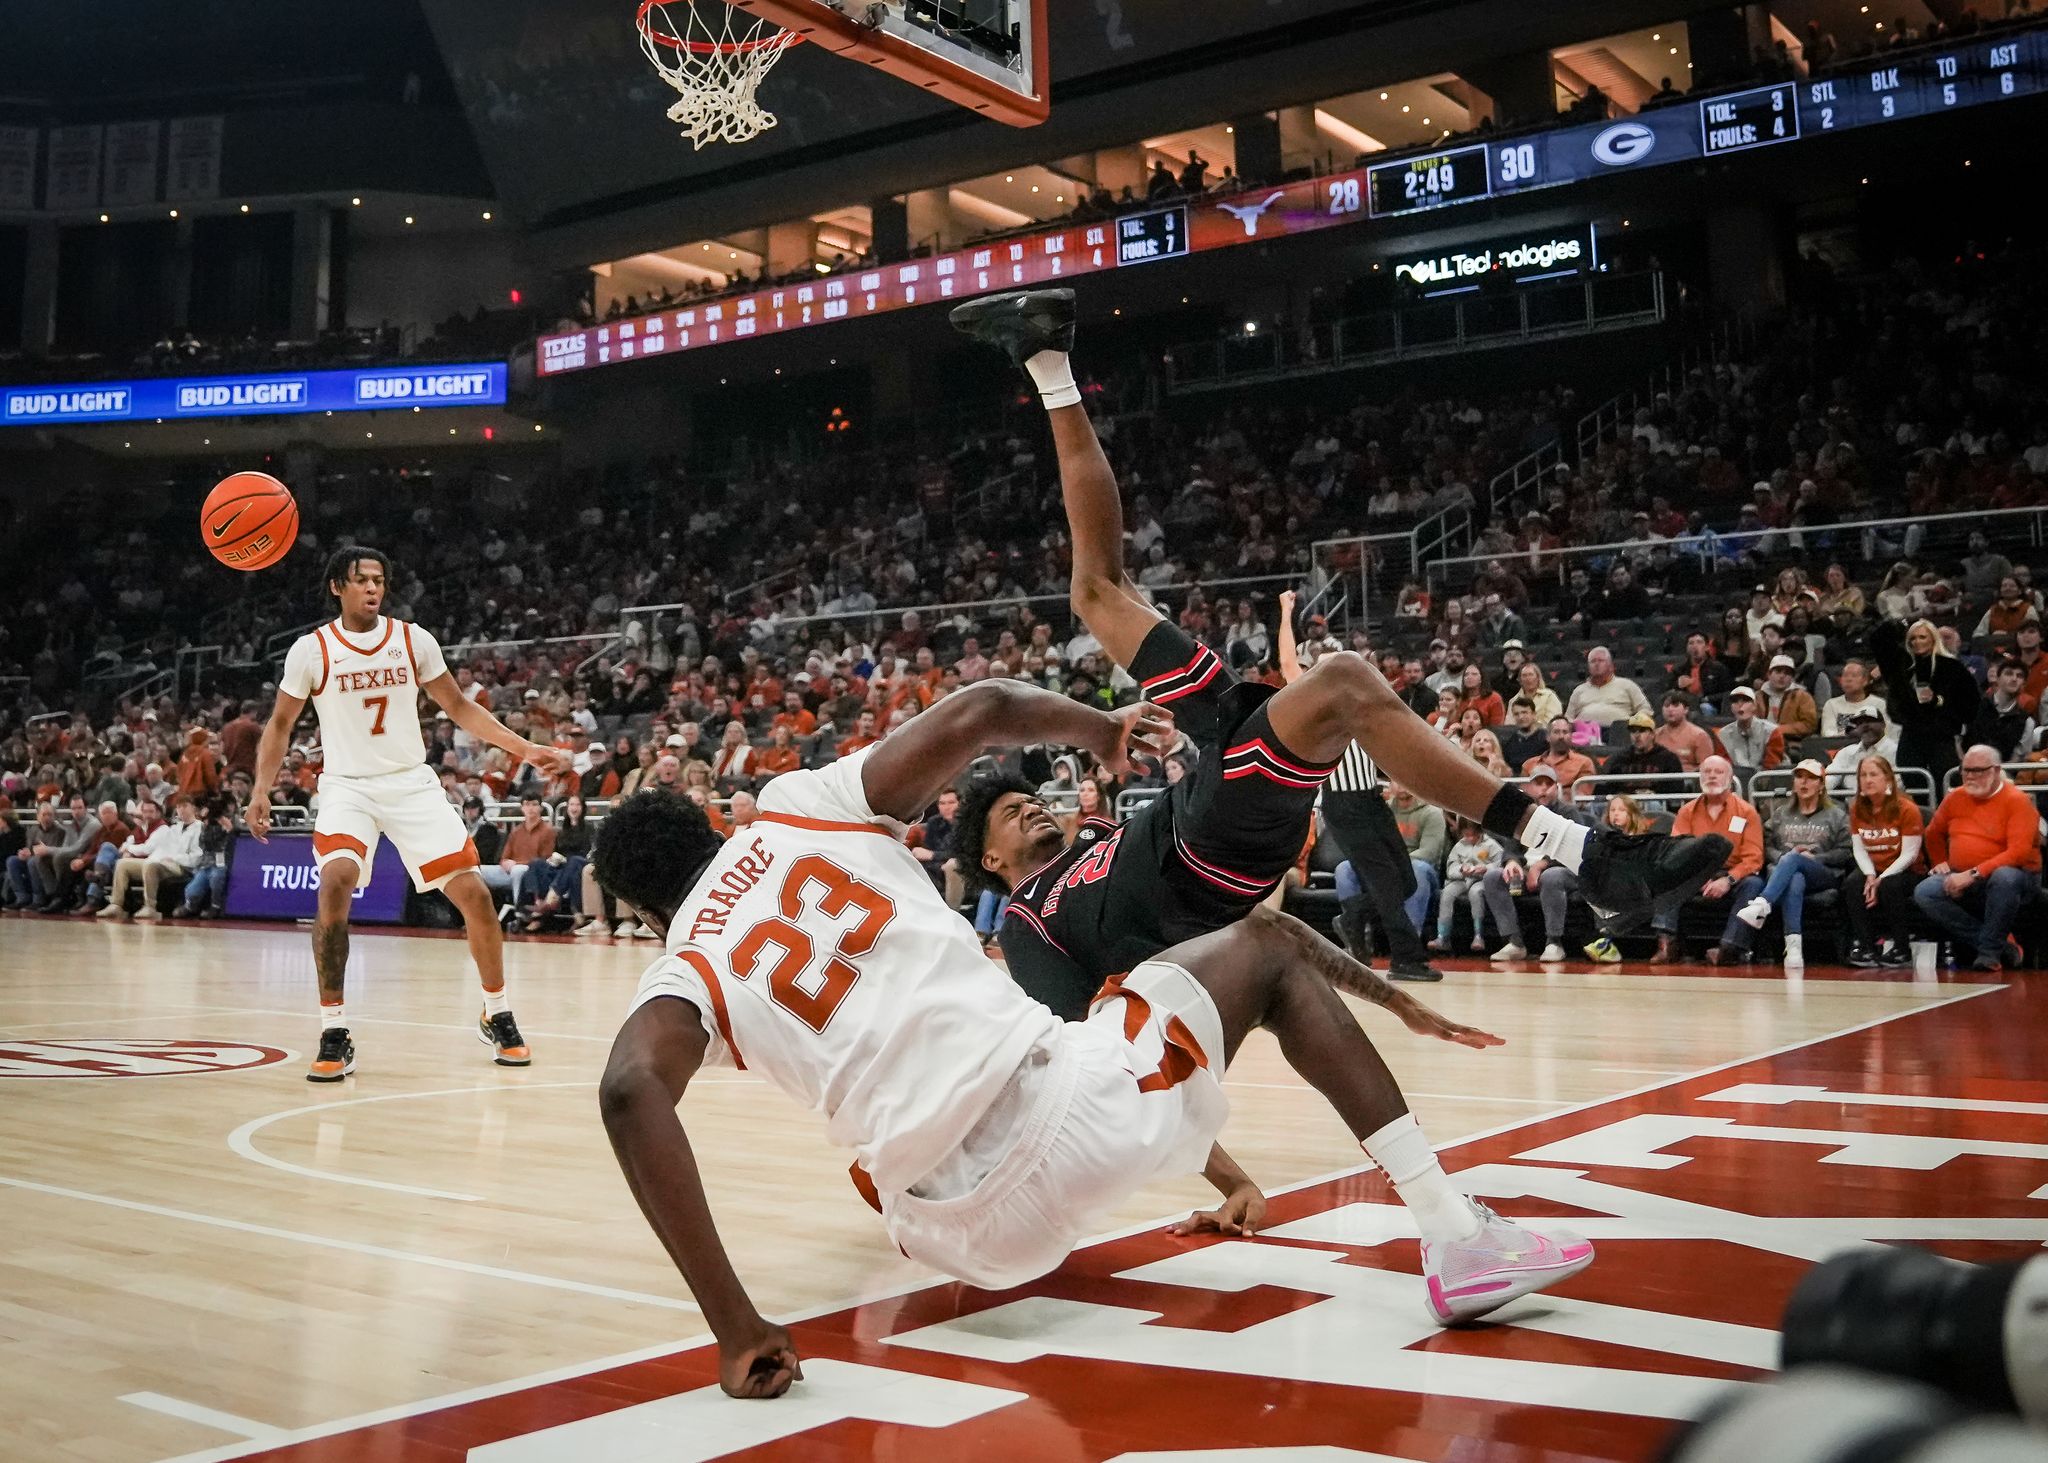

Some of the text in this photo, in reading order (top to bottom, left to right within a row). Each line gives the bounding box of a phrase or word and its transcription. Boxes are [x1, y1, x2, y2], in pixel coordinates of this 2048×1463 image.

[1811, 44, 2018, 103] STL BLK TO AST
[1708, 91, 1784, 124] TOL: 3
[1821, 72, 2014, 130] 2 3 5 6
[1709, 116, 1785, 150] FOULS: 4
[1500, 143, 1536, 182] 30
[1329, 178, 1360, 215] 28
[1404, 163, 1455, 200] 2:49
[1165, 234, 1175, 253] 7
[543, 333, 587, 359] TEXAS
[10, 390, 127, 416] BUD LIGHT
[180, 382, 303, 408] BUD LIGHT
[360, 373, 487, 400] BUD LIGHT
[223, 533, 276, 562] ELITE
[335, 666, 409, 694] TEXAS
[362, 695, 390, 737] 7
[261, 864, 320, 890] TRUIS
[688, 836, 775, 941] TRAORE
[727, 853, 898, 1036] 23
